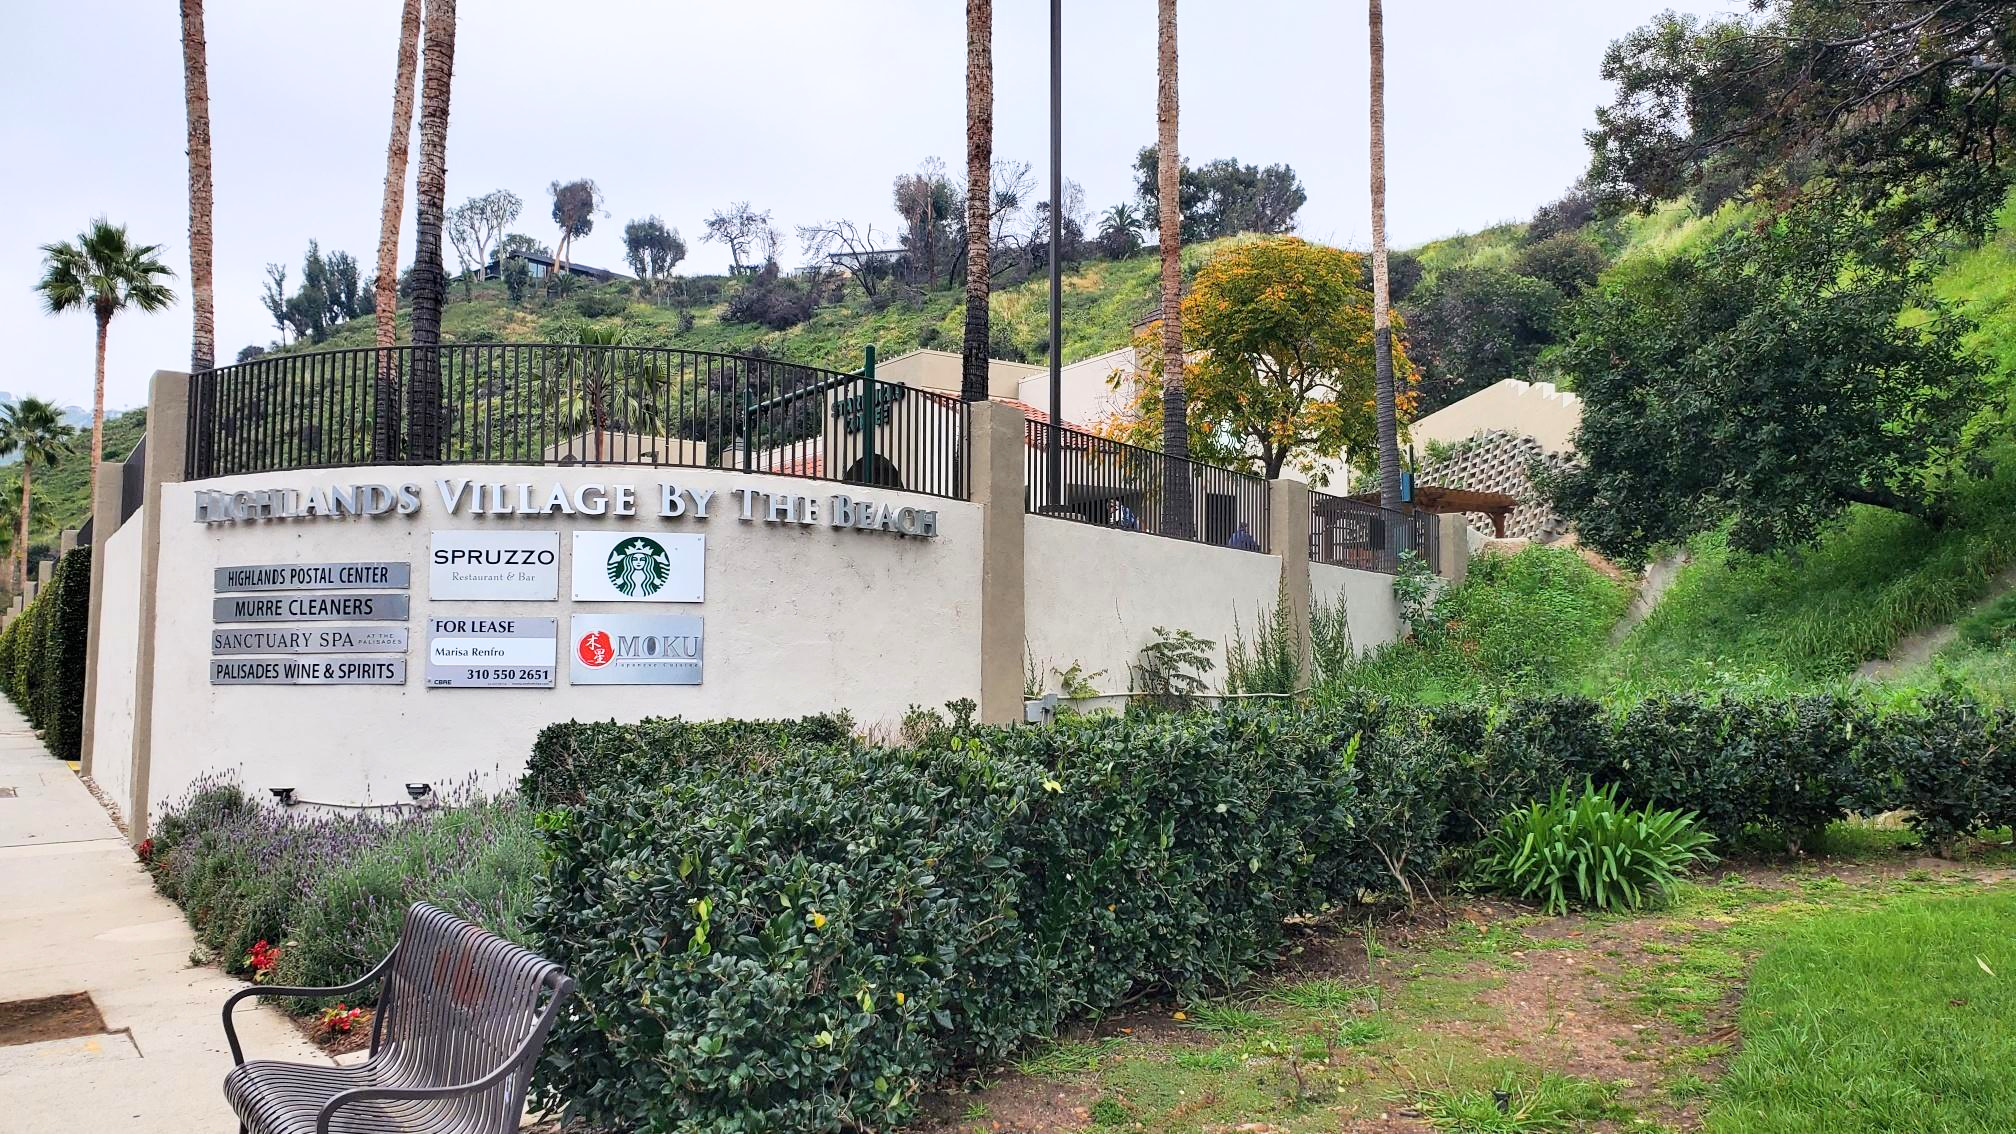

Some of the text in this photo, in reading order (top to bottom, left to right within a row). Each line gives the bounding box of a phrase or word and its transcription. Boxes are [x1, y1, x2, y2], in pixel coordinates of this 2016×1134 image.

[194, 482, 422, 523] HIGHLANDS
[434, 478, 636, 517] VILLAGE
[730, 488, 820, 525] THE
[831, 493, 938, 538] BEACH
[434, 549, 555, 566] SPRUZZO
[228, 566, 388, 587] HIGHLANDS POSTAL CENTER
[452, 572, 536, 582] Restaurant & Bar
[235, 598, 373, 617] MURRE CLEANERS
[435, 620, 515, 633] FOR LEASE
[214, 632, 354, 649] SANCTUARY SPA
[617, 635, 700, 658] MOKU
[435, 646, 505, 657] Marisa Renfro
[216, 663, 395, 680] PALISADES WINE & SPIRITS
[467, 669, 549, 680] 310 550 2651
